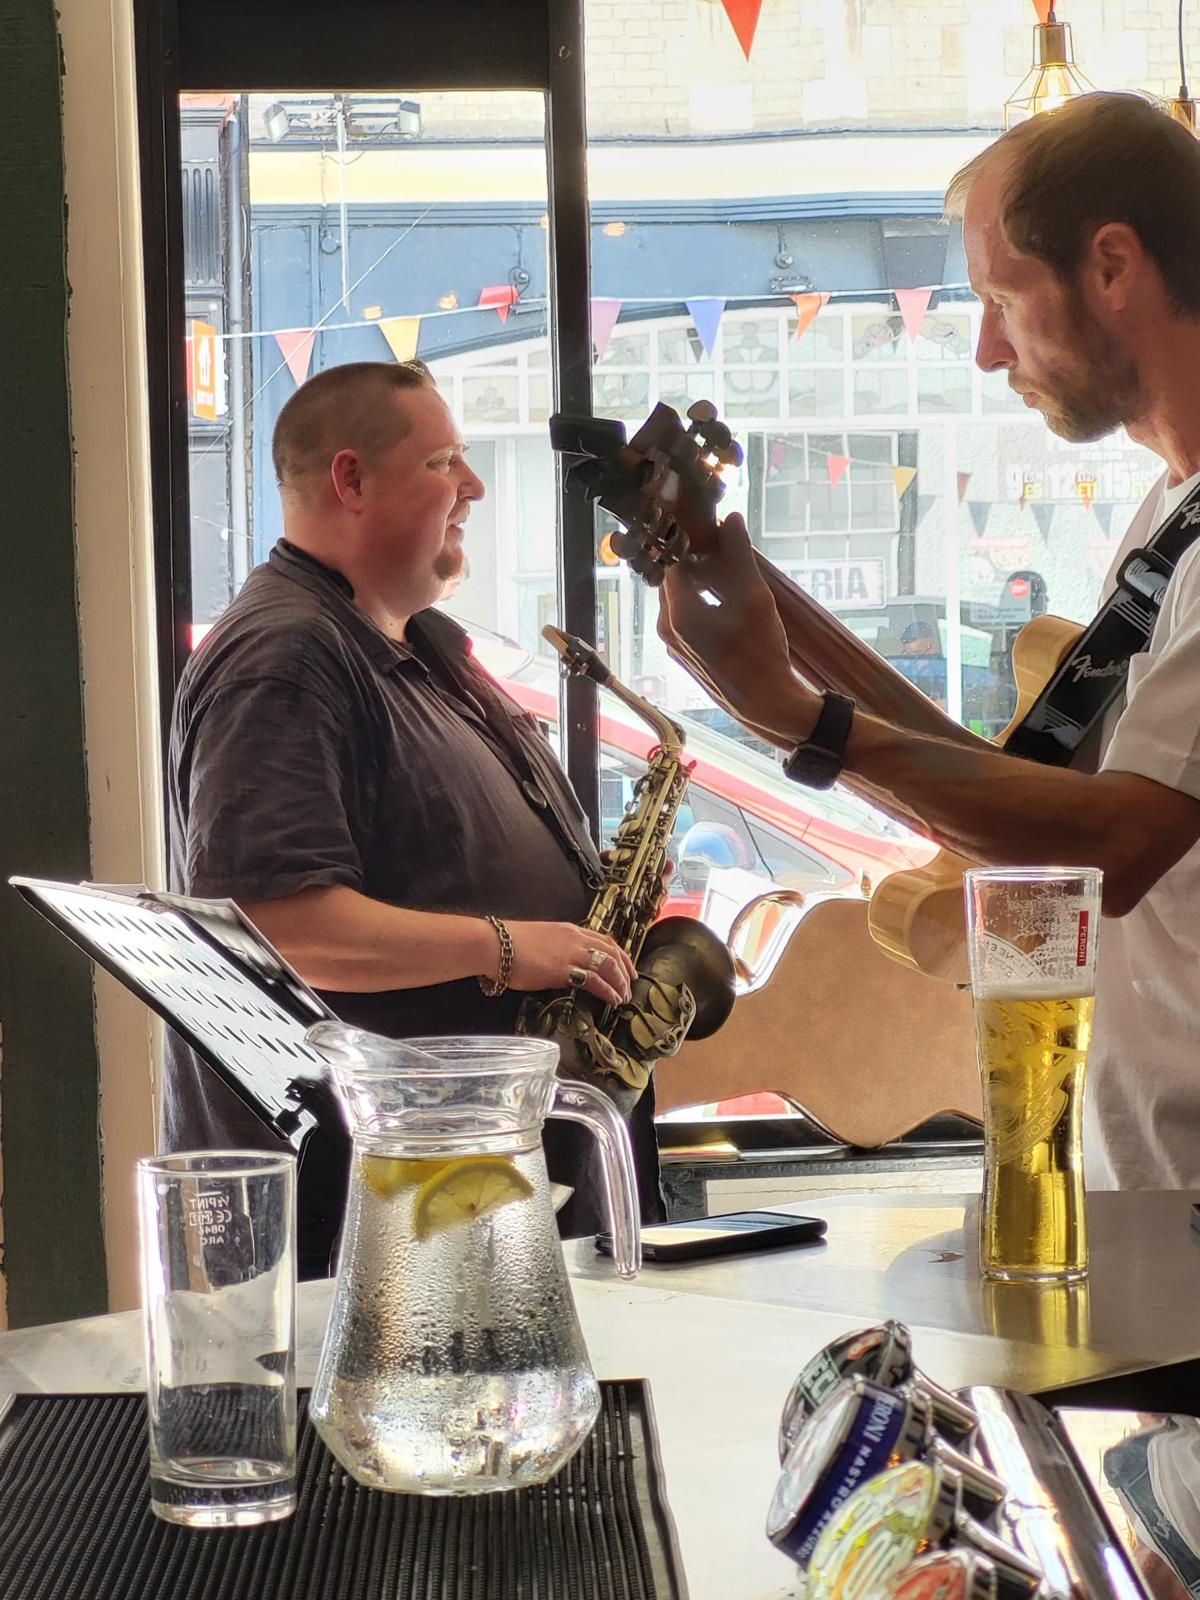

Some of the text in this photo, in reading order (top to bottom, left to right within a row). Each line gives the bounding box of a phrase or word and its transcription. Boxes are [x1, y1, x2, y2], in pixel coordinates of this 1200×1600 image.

[1071, 654, 1123, 683] Fender
[1079, 925, 1087, 962] PERONI
[831, 1445, 872, 1509] NASTRO
